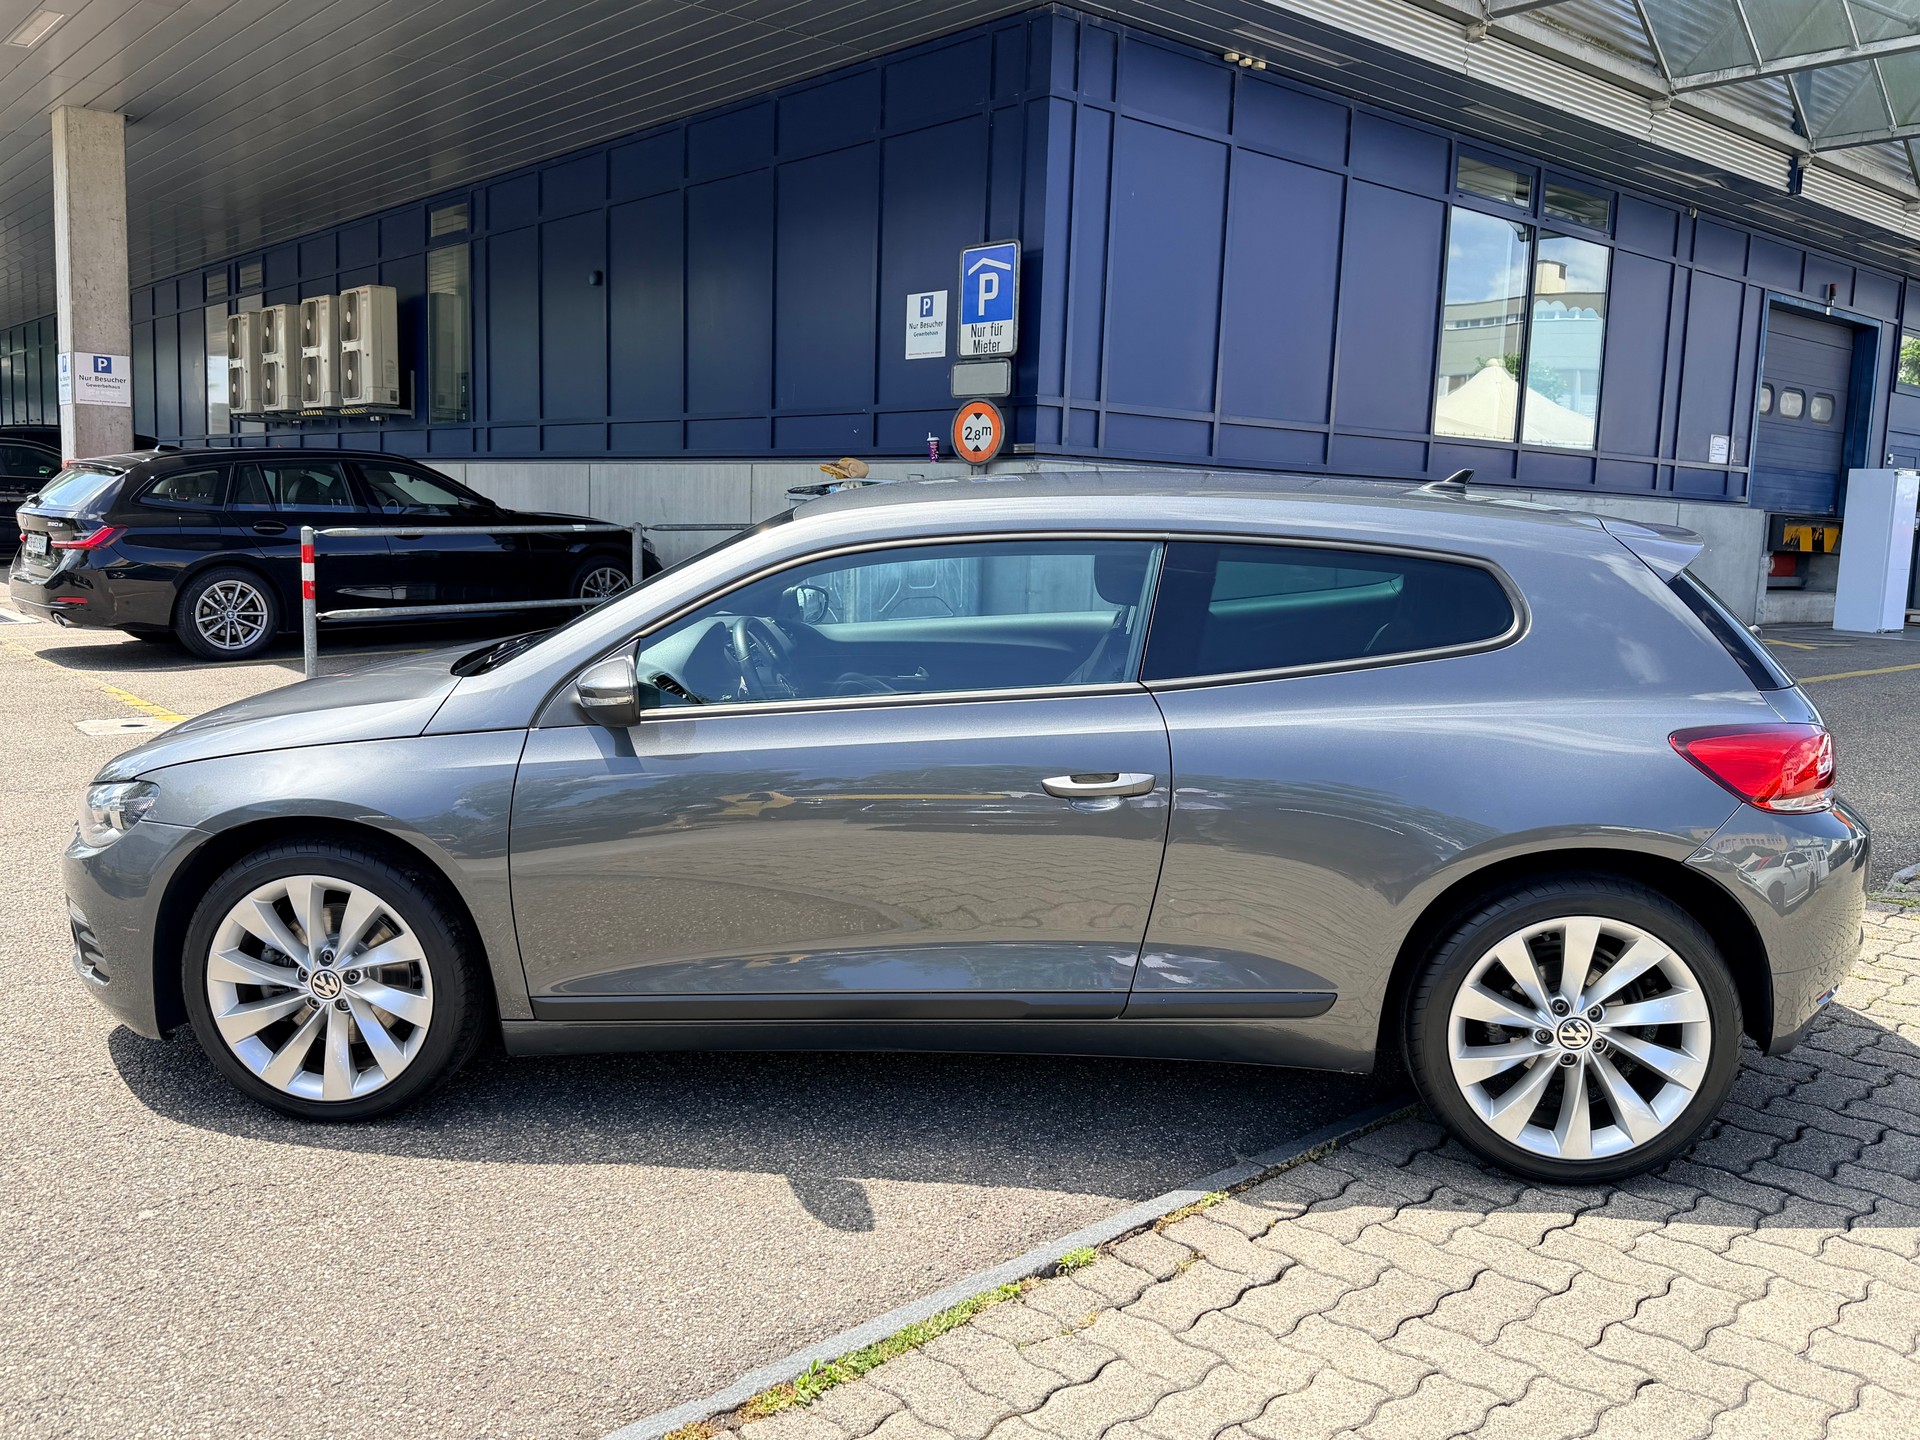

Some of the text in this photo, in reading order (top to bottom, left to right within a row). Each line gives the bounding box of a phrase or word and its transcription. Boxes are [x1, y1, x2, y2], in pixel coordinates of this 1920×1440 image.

[978, 272, 999, 316] P
[923, 298, 931, 315] P
[920, 320, 944, 329] Besucher
[971, 322, 1003, 338] Nur für
[973, 339, 1000, 354] Mieter
[97, 357, 108, 372] P
[79, 374, 92, 382] Nur
[94, 375, 127, 384] Besucher
